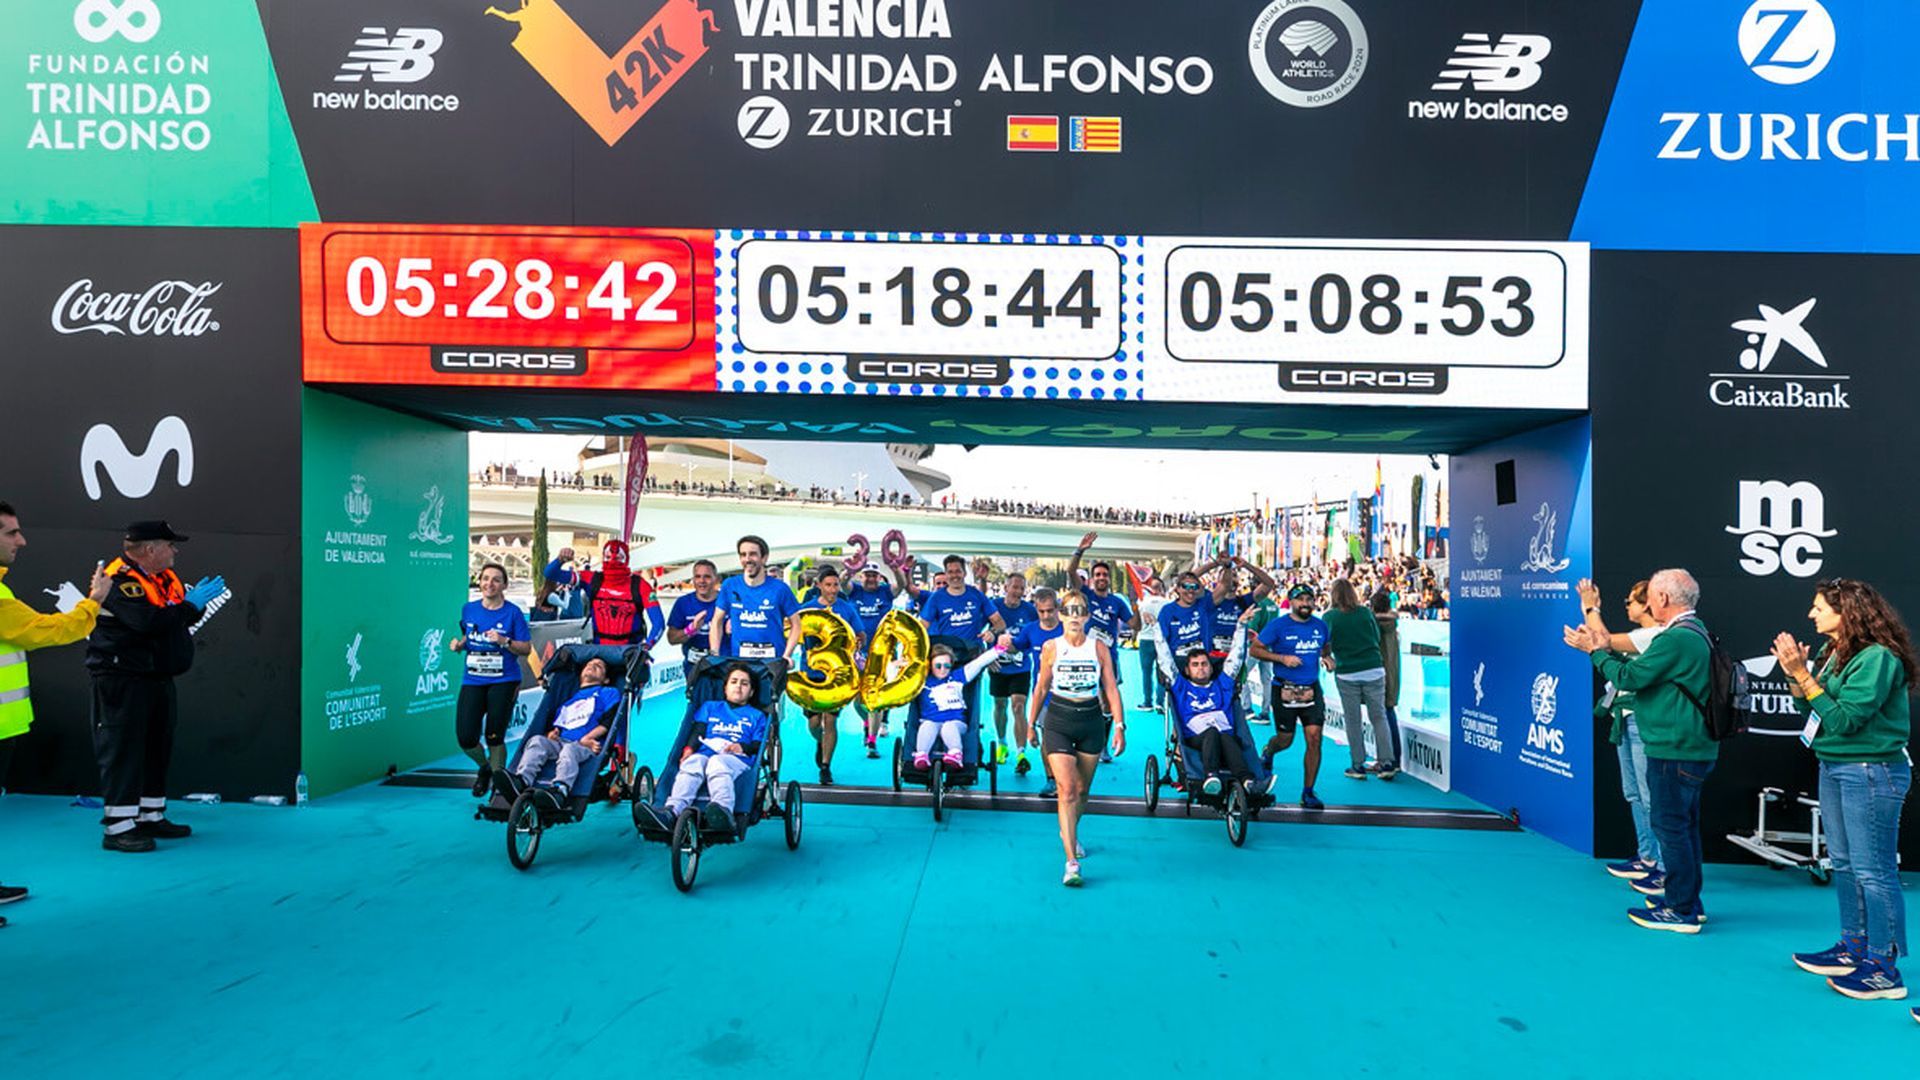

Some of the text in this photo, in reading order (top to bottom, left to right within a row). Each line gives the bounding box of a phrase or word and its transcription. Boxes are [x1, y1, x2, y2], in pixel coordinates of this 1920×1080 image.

[1252, 5, 1280, 50] PLATINUM
[29, 51, 209, 75] FUNDACIÓN
[605, 24, 685, 115] 42K
[734, 53, 1214, 94] TRINIDAD ALFONSO
[1282, 69, 1335, 78] ATHLETICS
[1290, 60, 1326, 69] WORLD
[1306, 48, 1364, 102] ROAD RACE 2024
[27, 83, 211, 115] TRINIDAD
[313, 89, 459, 112] new balance
[1408, 98, 1568, 122] new balance
[27, 118, 211, 151] ALFONSO
[807, 108, 952, 137] ZURICH
[1656, 112, 1920, 161] ZURICH
[346, 256, 678, 322] 05:28:42
[758, 264, 1101, 329] 05:18:44
[1180, 271, 1535, 337] 05:08:53
[442, 352, 576, 369] COROS
[858, 361, 998, 379] COROS
[1291, 369, 1435, 387] COROS
[1709, 379, 1850, 408] CaixaBank
[324, 530, 387, 547] AJUNTAMENT
[324, 549, 339, 562] DE
[415, 672, 449, 696] AIMS
[326, 694, 381, 716] COMUNITAT
[329, 706, 387, 730] DE L'ESPORT
[1527, 722, 1565, 755] AIMS
[1407, 735, 1443, 775] YÁTOVA
